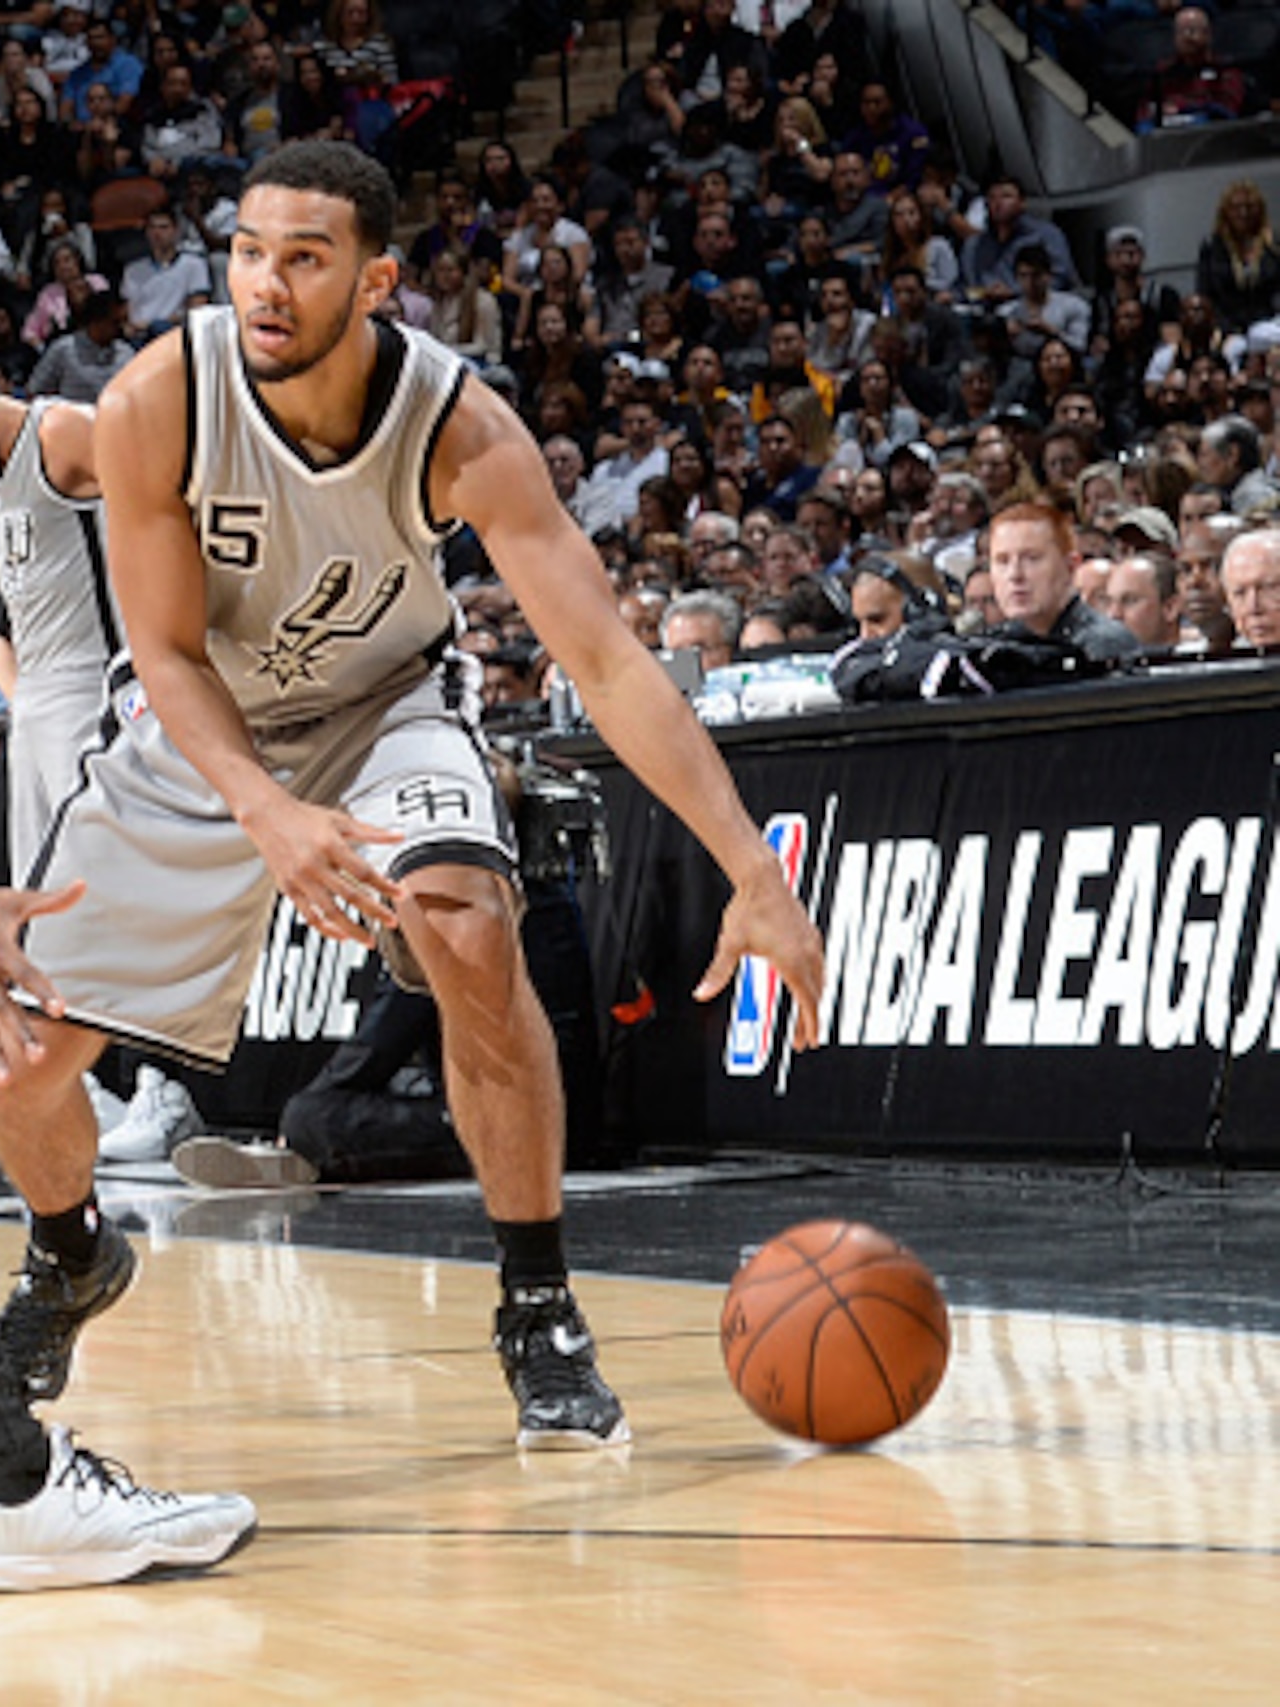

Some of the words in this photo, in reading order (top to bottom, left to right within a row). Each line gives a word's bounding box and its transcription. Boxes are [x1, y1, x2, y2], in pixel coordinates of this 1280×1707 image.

[204, 499, 266, 573] 5
[818, 833, 989, 1047] NBA
[983, 816, 1280, 1057] LEAGU
